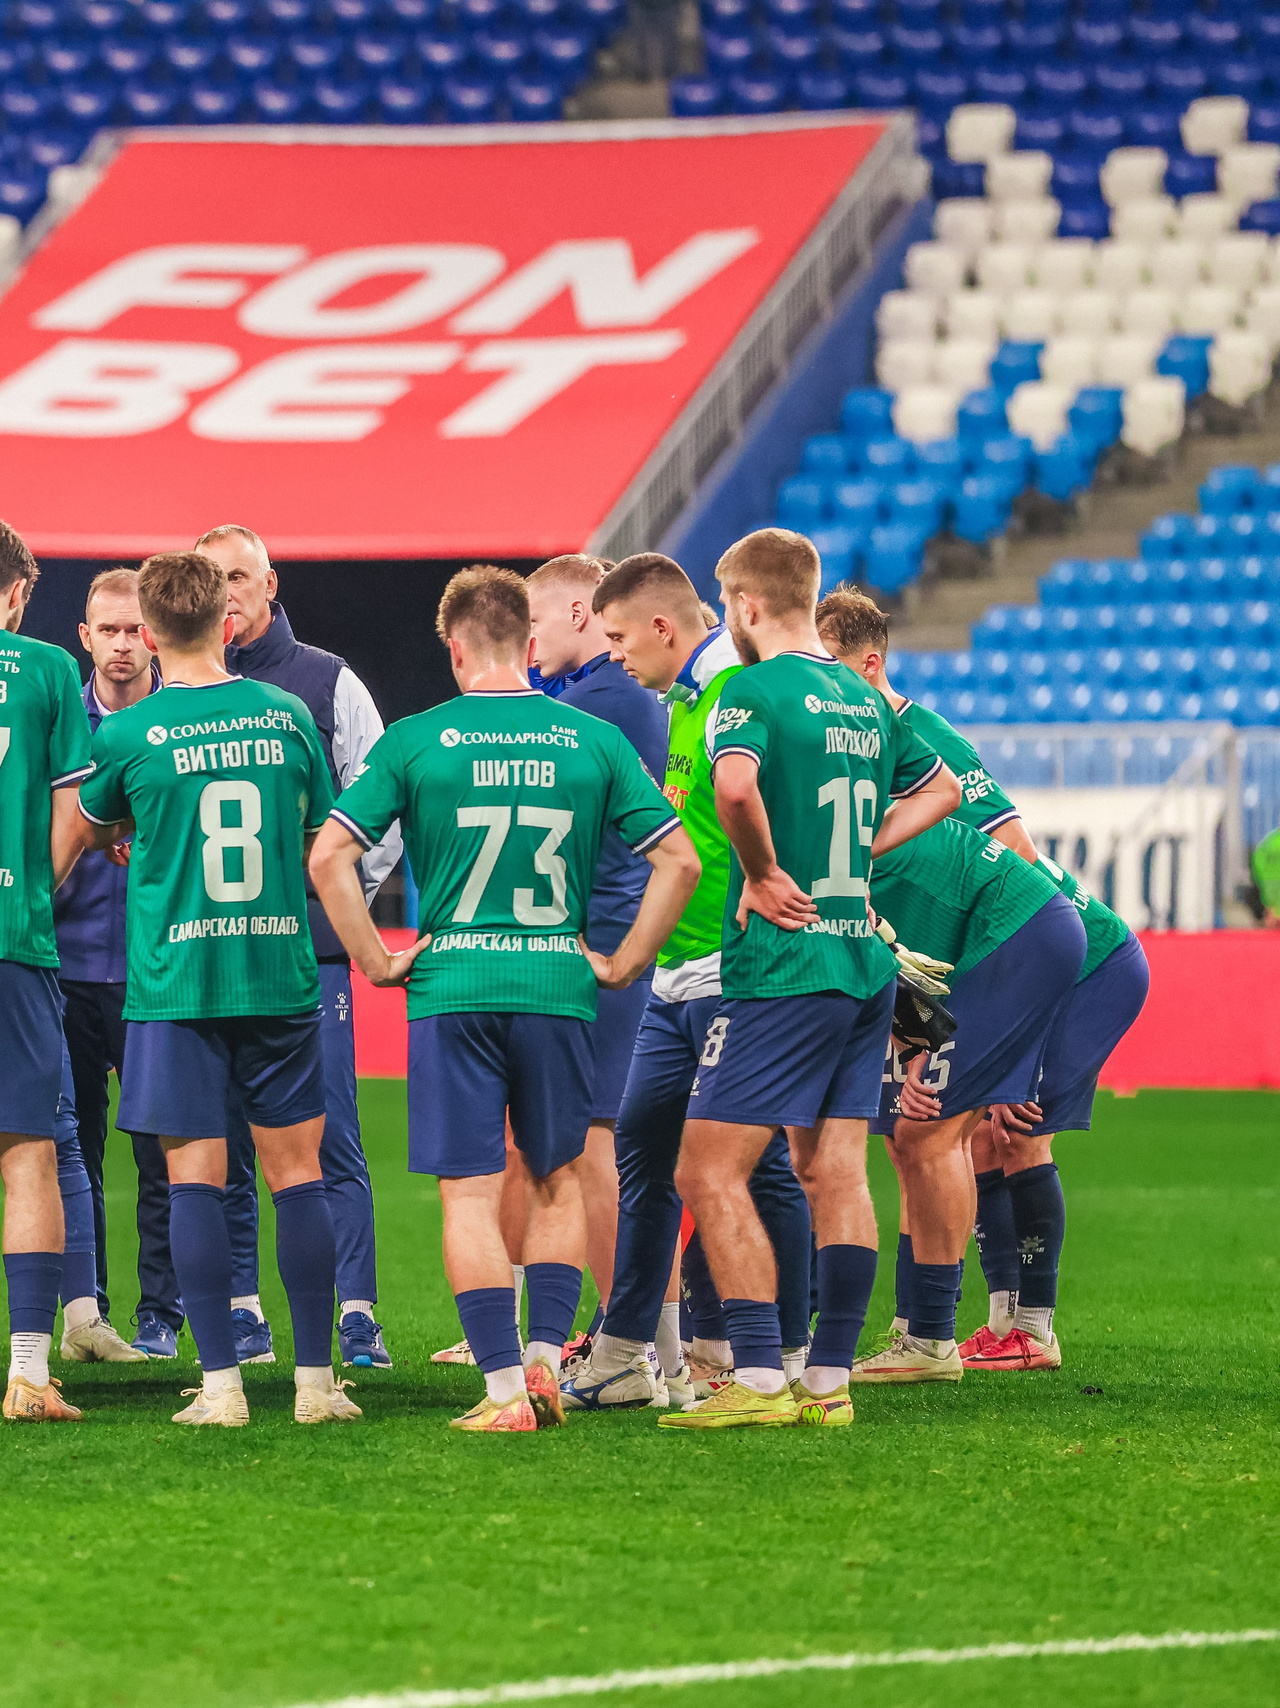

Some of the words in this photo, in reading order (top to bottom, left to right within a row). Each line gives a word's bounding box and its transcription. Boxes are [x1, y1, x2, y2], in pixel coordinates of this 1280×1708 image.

[29, 228, 760, 339] FON
[266, 708, 293, 720] БАНК
[716, 707, 753, 726] FON
[170, 716, 297, 740] СОЛИДАРНОСТЬ
[551, 725, 578, 736] БАНК
[461, 732, 579, 749] СОЛИДАРНОСТЬ
[173, 739, 285, 775] ВИТЮГОВ
[473, 759, 556, 788] ШИТОВ
[965, 780, 995, 804] BET
[199, 780, 263, 903] 8
[451, 805, 574, 926] 73
[804, 919, 874, 938] САМАРСКА
[432, 933, 522, 954] САМАРСКАЯ
